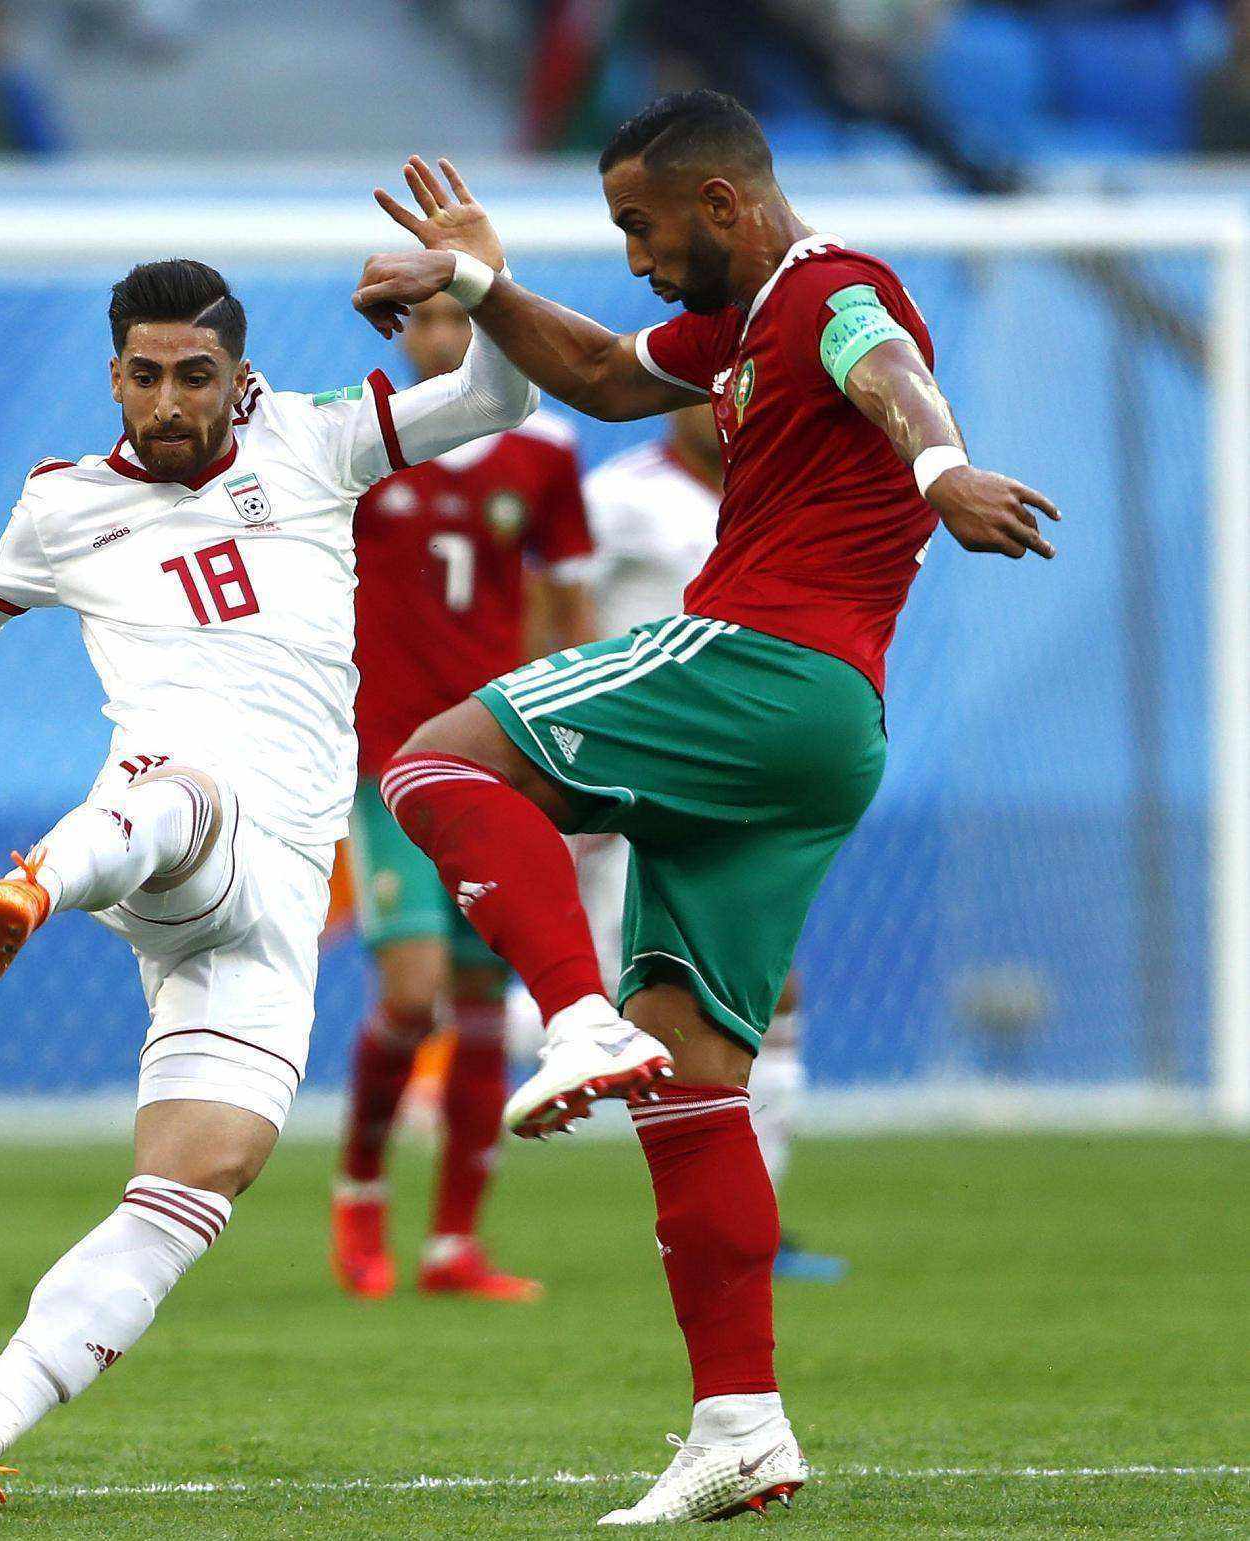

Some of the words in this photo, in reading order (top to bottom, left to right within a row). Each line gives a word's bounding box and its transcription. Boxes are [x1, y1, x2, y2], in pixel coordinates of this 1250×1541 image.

[92, 526, 131, 549] adidas
[160, 538, 261, 627] 18
[550, 725, 576, 764] adidas
